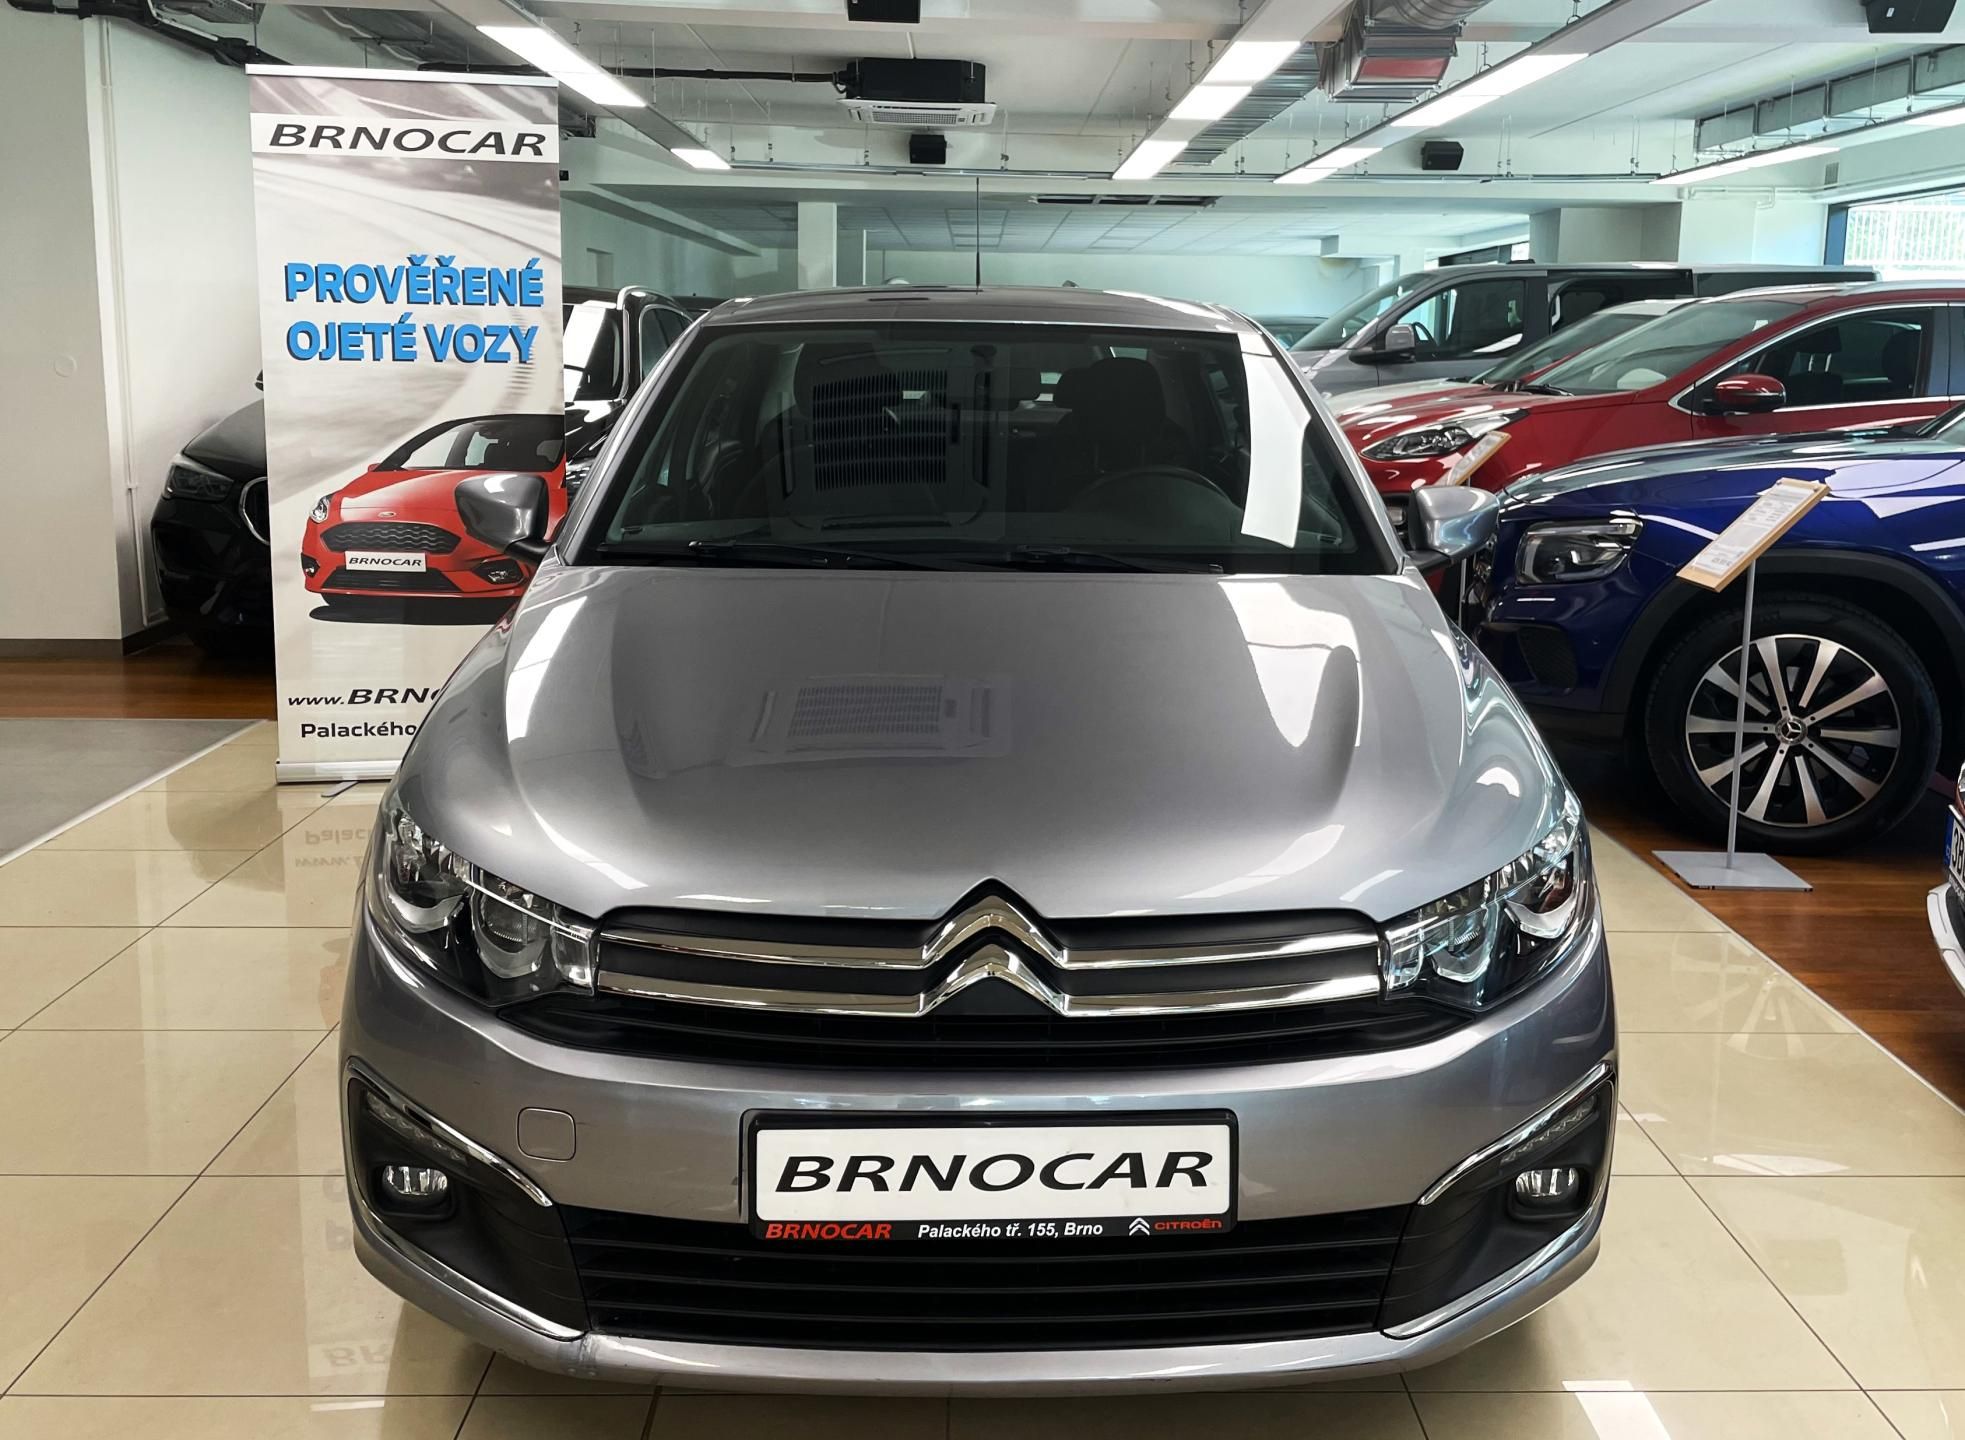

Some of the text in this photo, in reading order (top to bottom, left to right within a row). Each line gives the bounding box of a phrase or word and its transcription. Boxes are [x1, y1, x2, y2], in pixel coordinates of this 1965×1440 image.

[269, 123, 547, 156] BRNOCAR
[284, 254, 544, 307] PROVĚŘENÉ
[286, 312, 540, 363] OJETÉ VOZY
[349, 557, 422, 567] BRNOCAR
[301, 721, 417, 738] Palackého
[1952, 826, 1965, 884] 3B
[775, 1151, 1214, 1192] BRNOCAR
[765, 1223, 892, 1240] BRNOCAR
[918, 1222, 1104, 1238] Palackého tř. 155, Brno
